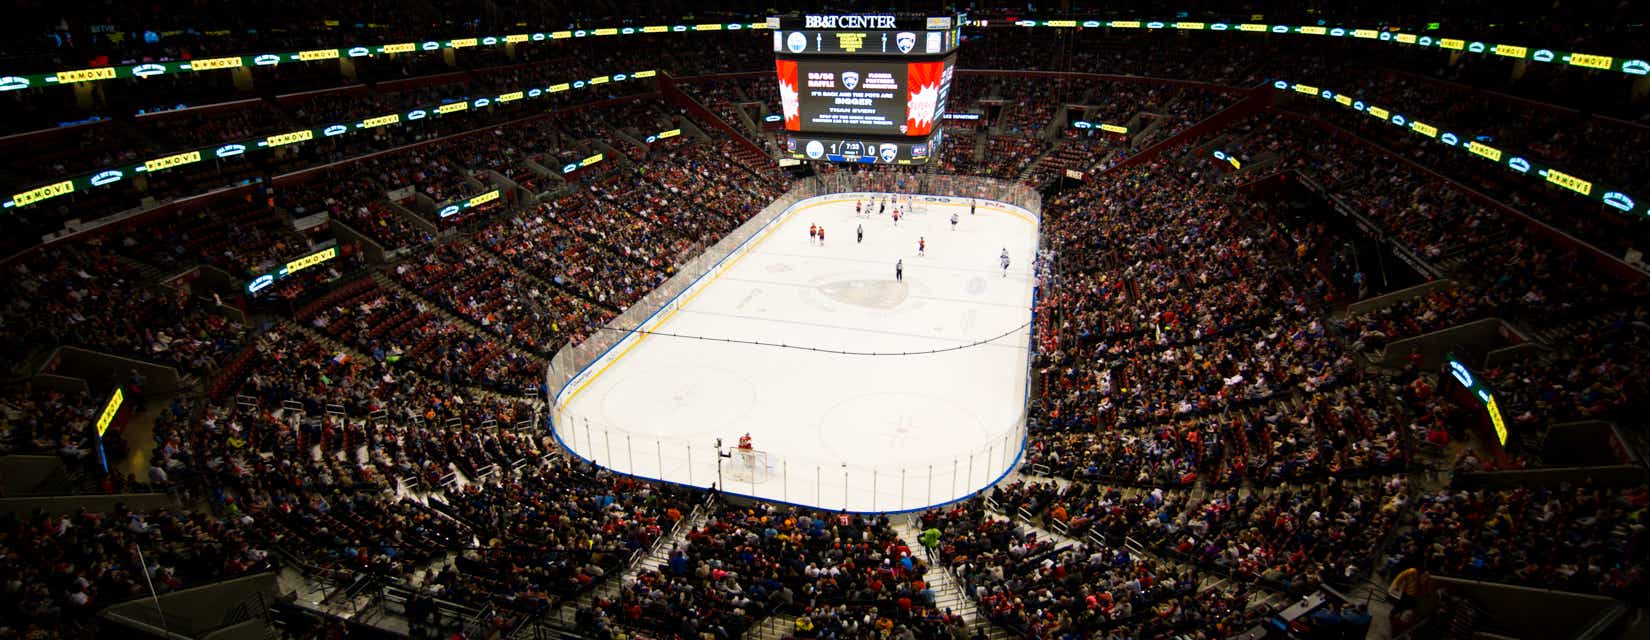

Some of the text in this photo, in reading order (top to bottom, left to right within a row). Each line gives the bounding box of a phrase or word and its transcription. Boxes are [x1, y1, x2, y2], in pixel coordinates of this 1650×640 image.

[805, 16, 896, 28] BB&T CENTER
[831, 144, 836, 153] 1
[868, 145, 875, 155] 0
